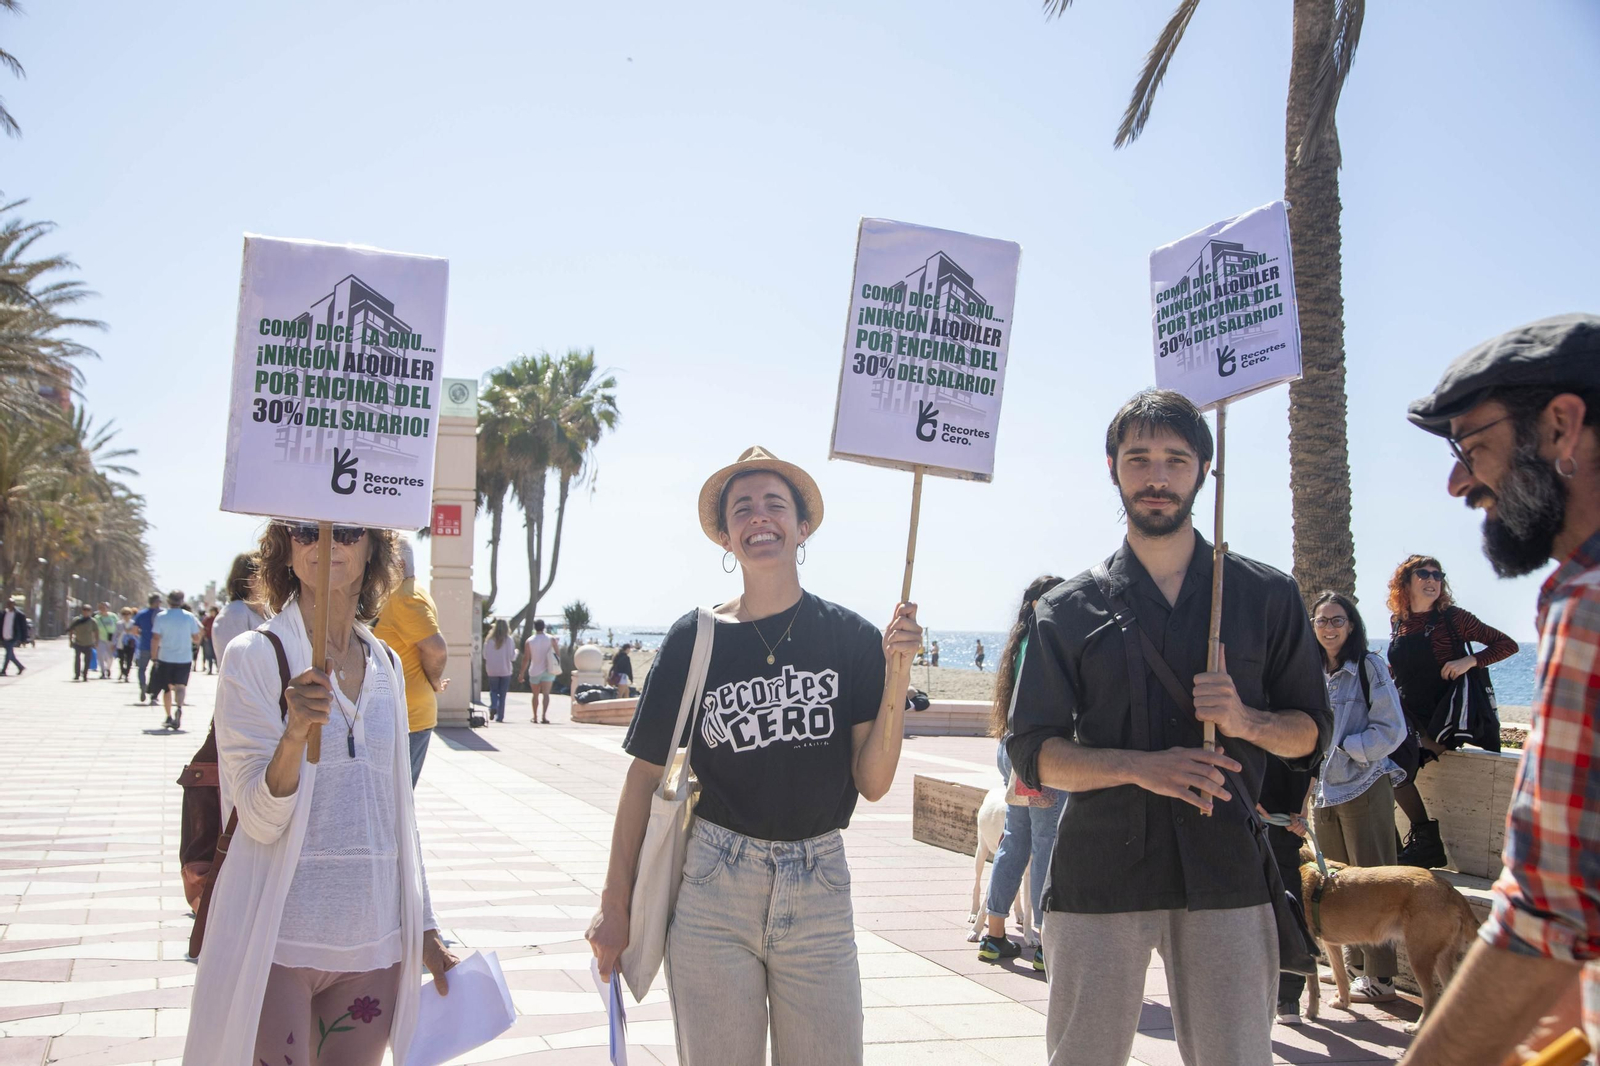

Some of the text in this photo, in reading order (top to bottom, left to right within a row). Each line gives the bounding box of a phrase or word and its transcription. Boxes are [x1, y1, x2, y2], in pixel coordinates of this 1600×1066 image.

[861, 284, 903, 304] COMO
[909, 291, 940, 310] DICE
[946, 299, 961, 315] LA
[1156, 282, 1188, 304] COMO
[1192, 269, 1218, 289] DICE
[1223, 262, 1238, 277] LA
[1157, 265, 1280, 323] ¡NINGÚN ALQUILER
[858, 306, 1002, 347] ¡NINGÚN ALQUILER
[1158, 282, 1282, 340] POR ENCIMA DEL
[1159, 302, 1284, 358] 30% DEL SALARIO!
[259, 318, 308, 339] COMO
[315, 323, 353, 343] DICE
[361, 328, 380, 347] LA
[855, 328, 998, 372] POR ENCIMA DEL
[1241, 342, 1286, 362] Recortes
[256, 344, 434, 381] ¡NINGÚN ALQUILER
[852, 352, 997, 396] 30% DEL SALARIO!
[1241, 355, 1270, 369] Cero.
[254, 370, 432, 410] POR ENCIMA DEL
[252, 397, 431, 438] 30% DEL SALARIO!
[942, 422, 990, 439] Recortes
[941, 432, 972, 446] Cero.
[363, 483, 402, 497] Cero.
[364, 472, 425, 487] Recortes
[728, 704, 835, 753] CERO
